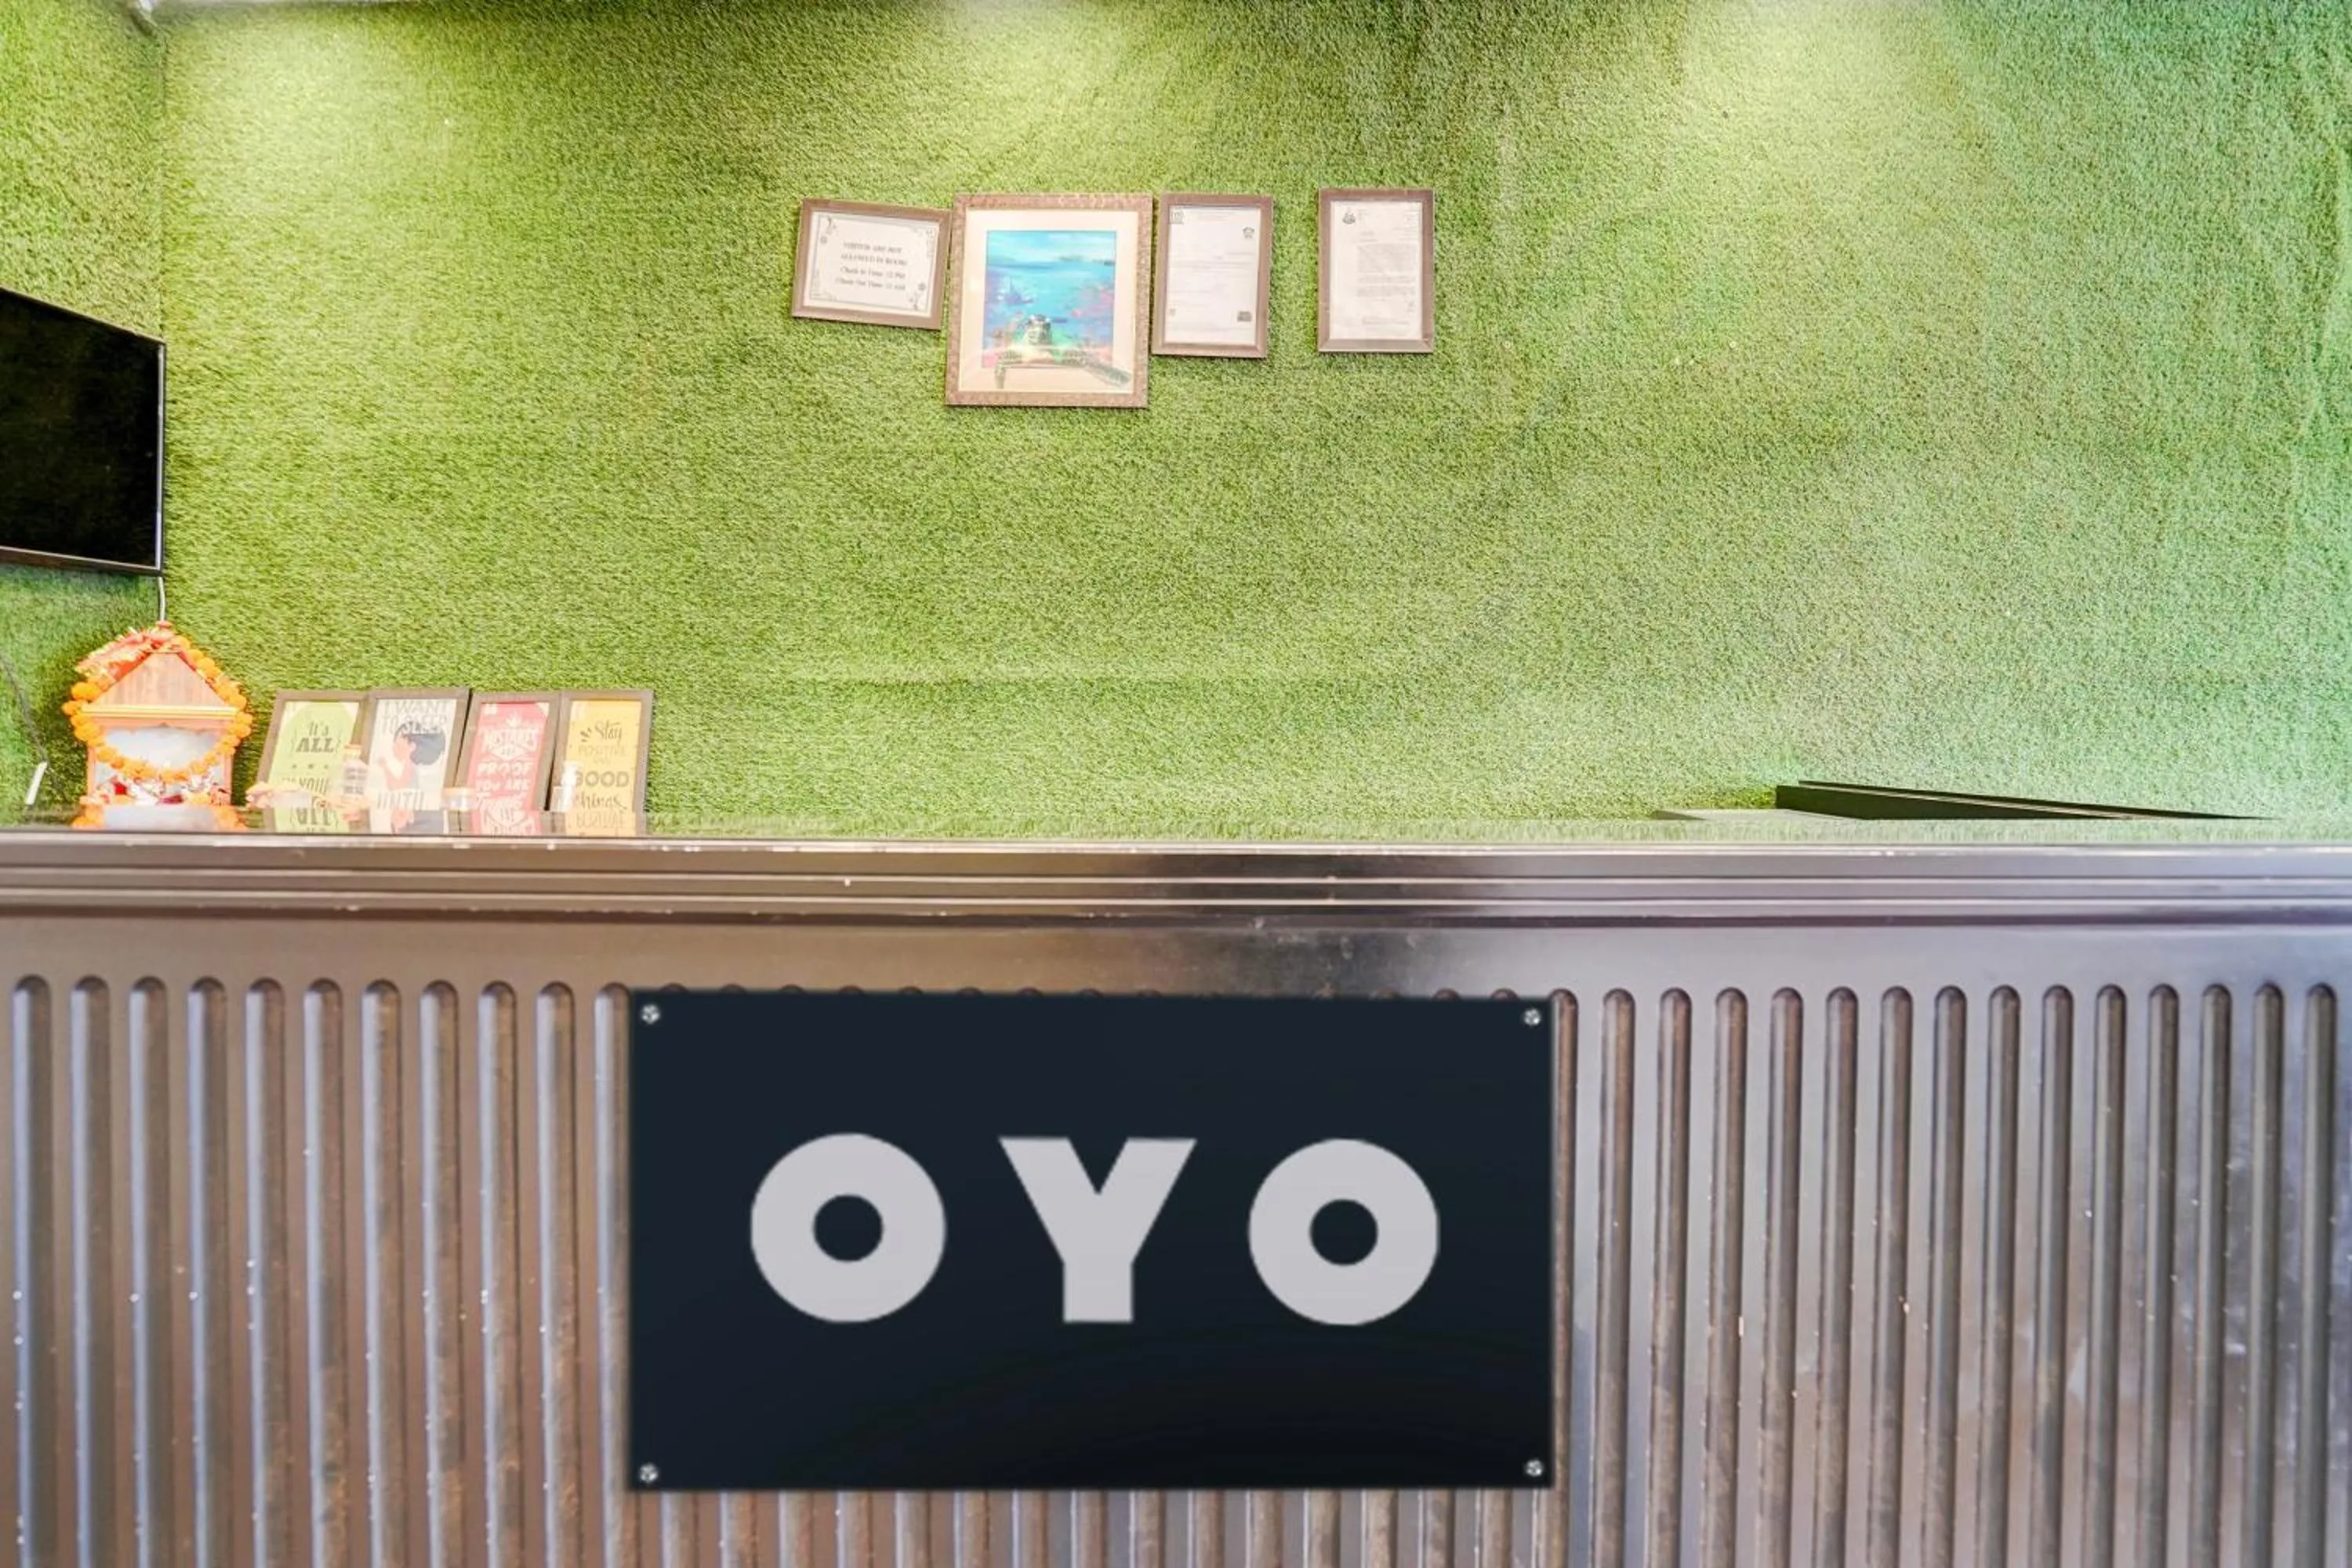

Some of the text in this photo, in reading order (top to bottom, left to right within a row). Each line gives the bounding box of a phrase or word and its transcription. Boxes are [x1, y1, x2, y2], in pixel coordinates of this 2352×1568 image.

[594, 719, 622, 746] Stay
[296, 738, 336, 753] ALL
[476, 761, 535, 777] PROOF
[750, 1133, 1439, 1325] OYO
